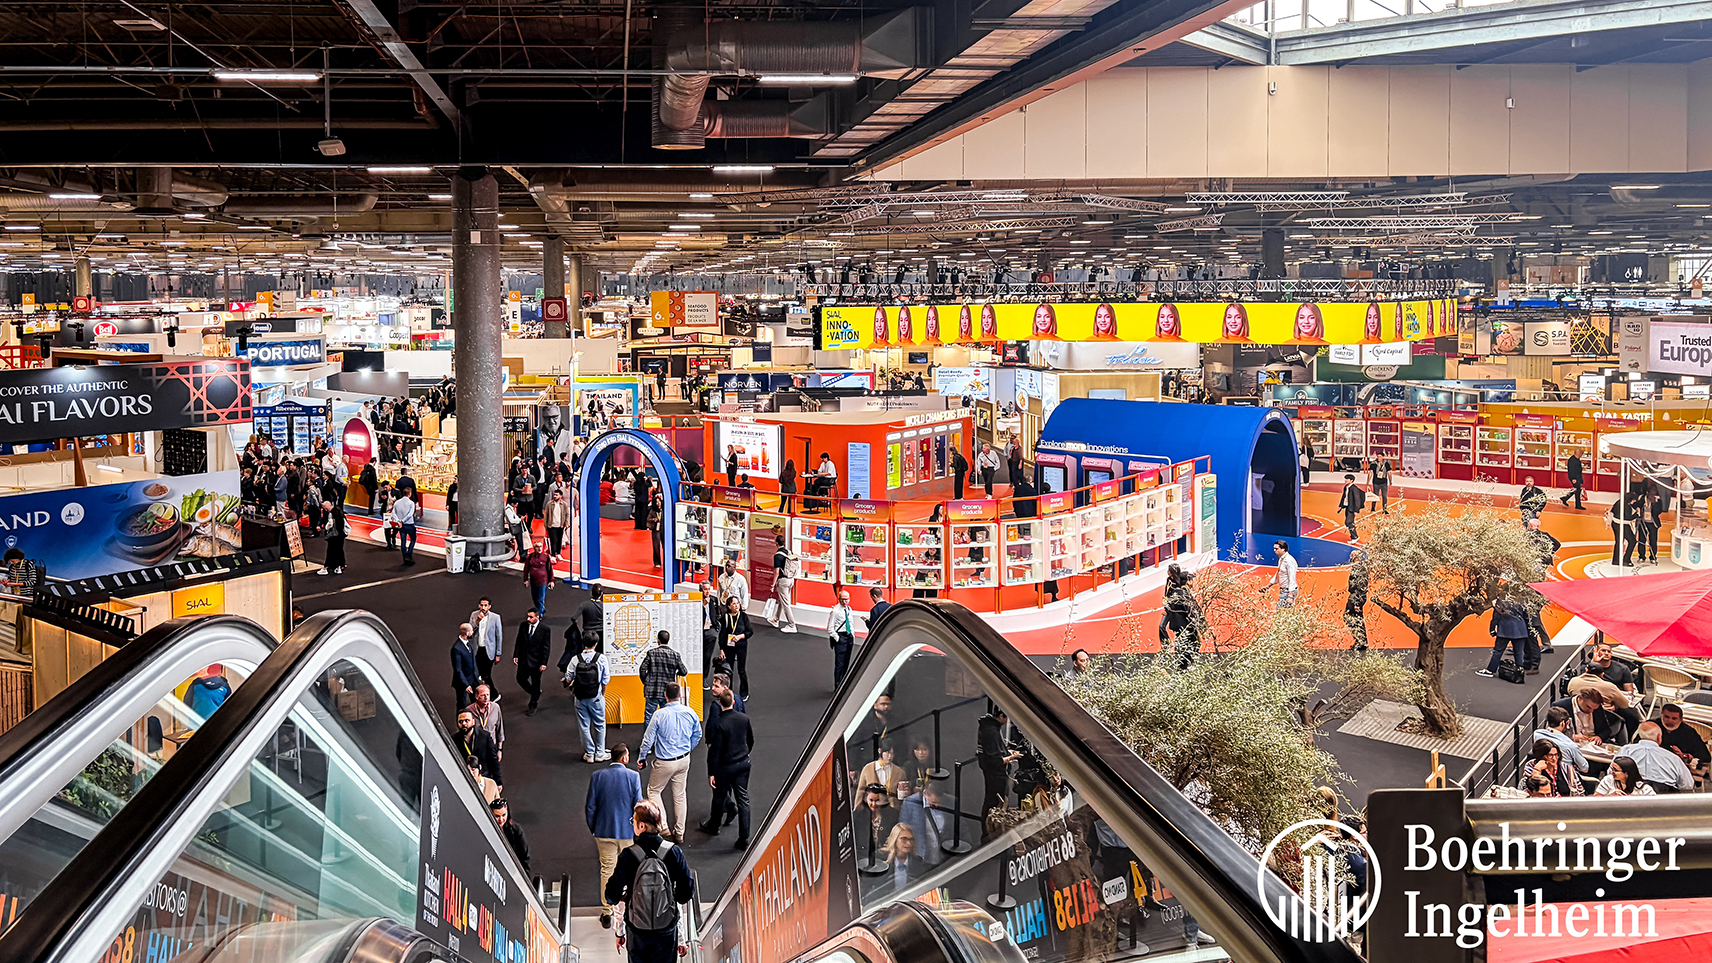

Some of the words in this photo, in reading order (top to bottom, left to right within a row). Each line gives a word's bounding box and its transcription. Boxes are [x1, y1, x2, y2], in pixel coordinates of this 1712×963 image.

[654, 310, 665, 320] 6.
[826, 310, 842, 319] SIAL
[826, 320, 852, 330] INNO-
[826, 331, 860, 341] -VATION
[1680, 335, 1712, 346] Trusted
[248, 344, 322, 361] PORTUGAL
[41, 383, 64, 394] THE
[66, 379, 128, 393] AUTHENTIC
[31, 394, 153, 423] FLAVORS
[905, 413, 925, 427] WORLD
[925, 408, 957, 424] CHAMPIONS
[956, 406, 970, 419] TOUR
[1040, 440, 1066, 449] Explore
[1066, 441, 1085, 450] more
[1086, 443, 1129, 454] innovations
[186, 597, 212, 611] SIAL
[758, 804, 822, 931] THAILAND
[177, 890, 187, 918] @
[443, 866, 462, 932] HALL
